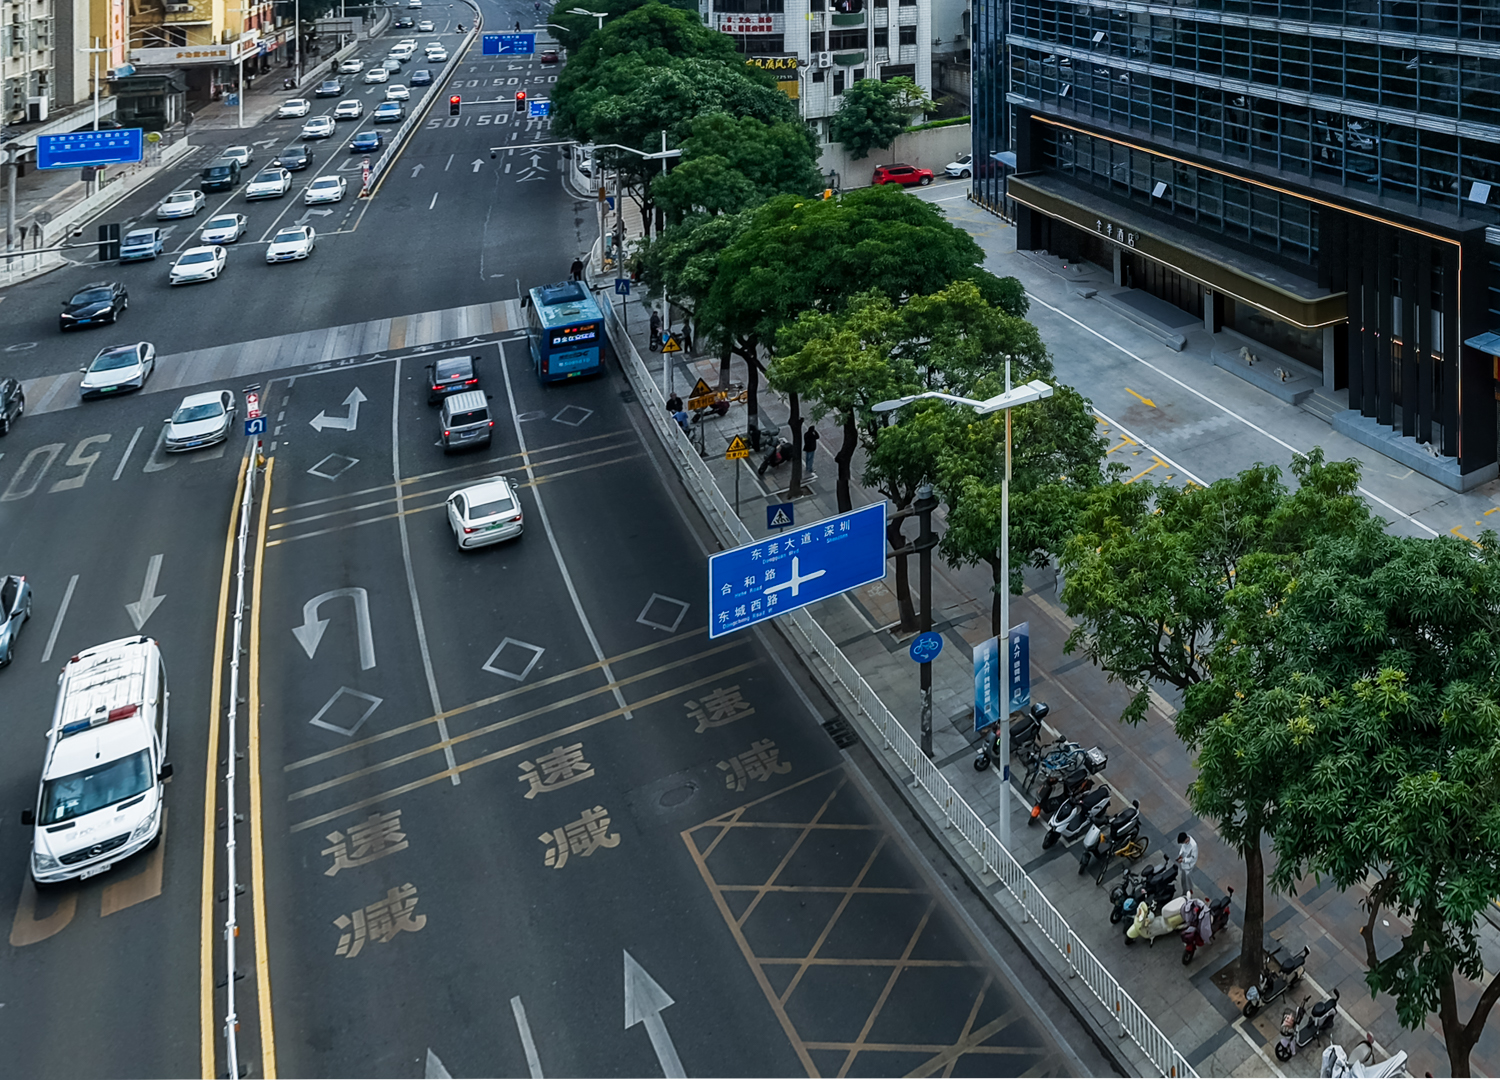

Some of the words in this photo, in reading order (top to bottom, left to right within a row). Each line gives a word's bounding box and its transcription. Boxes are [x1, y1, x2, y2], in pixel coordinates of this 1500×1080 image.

[451, 79, 479, 88] 50
[492, 77, 519, 87] 50
[533, 75, 558, 84] 50
[426, 117, 460, 129] 50
[476, 113, 509, 126] 50
[1096, 219, 1135, 248] 全季酒店
[720, 568, 777, 596] 合和路
[718, 593, 779, 624] 东城西路
